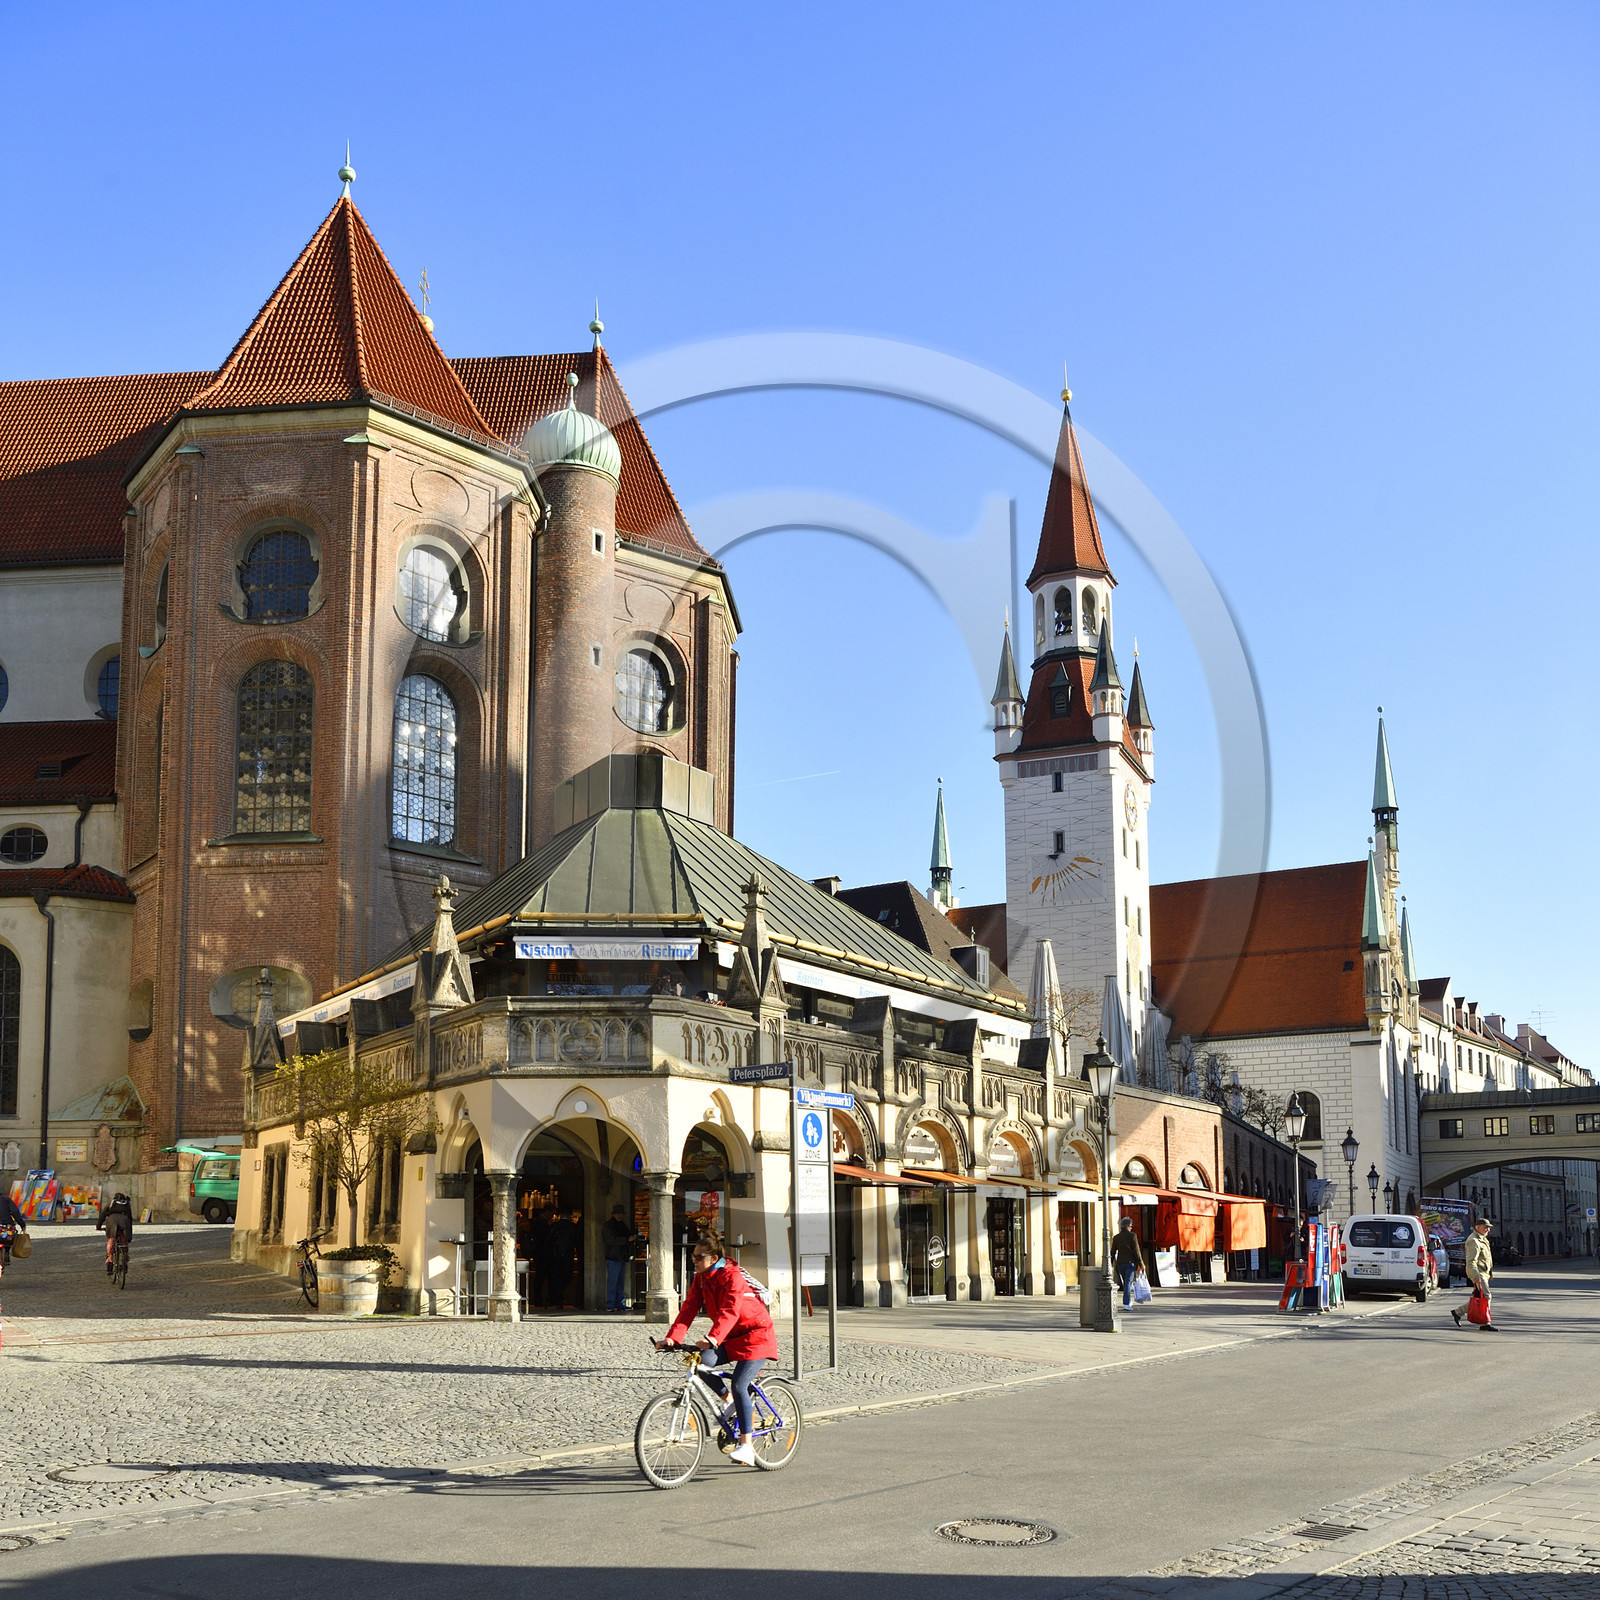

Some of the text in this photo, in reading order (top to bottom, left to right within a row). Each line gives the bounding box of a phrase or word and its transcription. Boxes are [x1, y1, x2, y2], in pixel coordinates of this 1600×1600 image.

[520, 943, 574, 957] Rischart
[600, 949, 612, 957] am
[614, 947, 637, 957] Markt
[642, 944, 695, 958] Rischart
[733, 1065, 784, 1080] Petersplatz
[805, 1150, 821, 1159] ZONE
[1443, 1206, 1469, 1215] Catering
